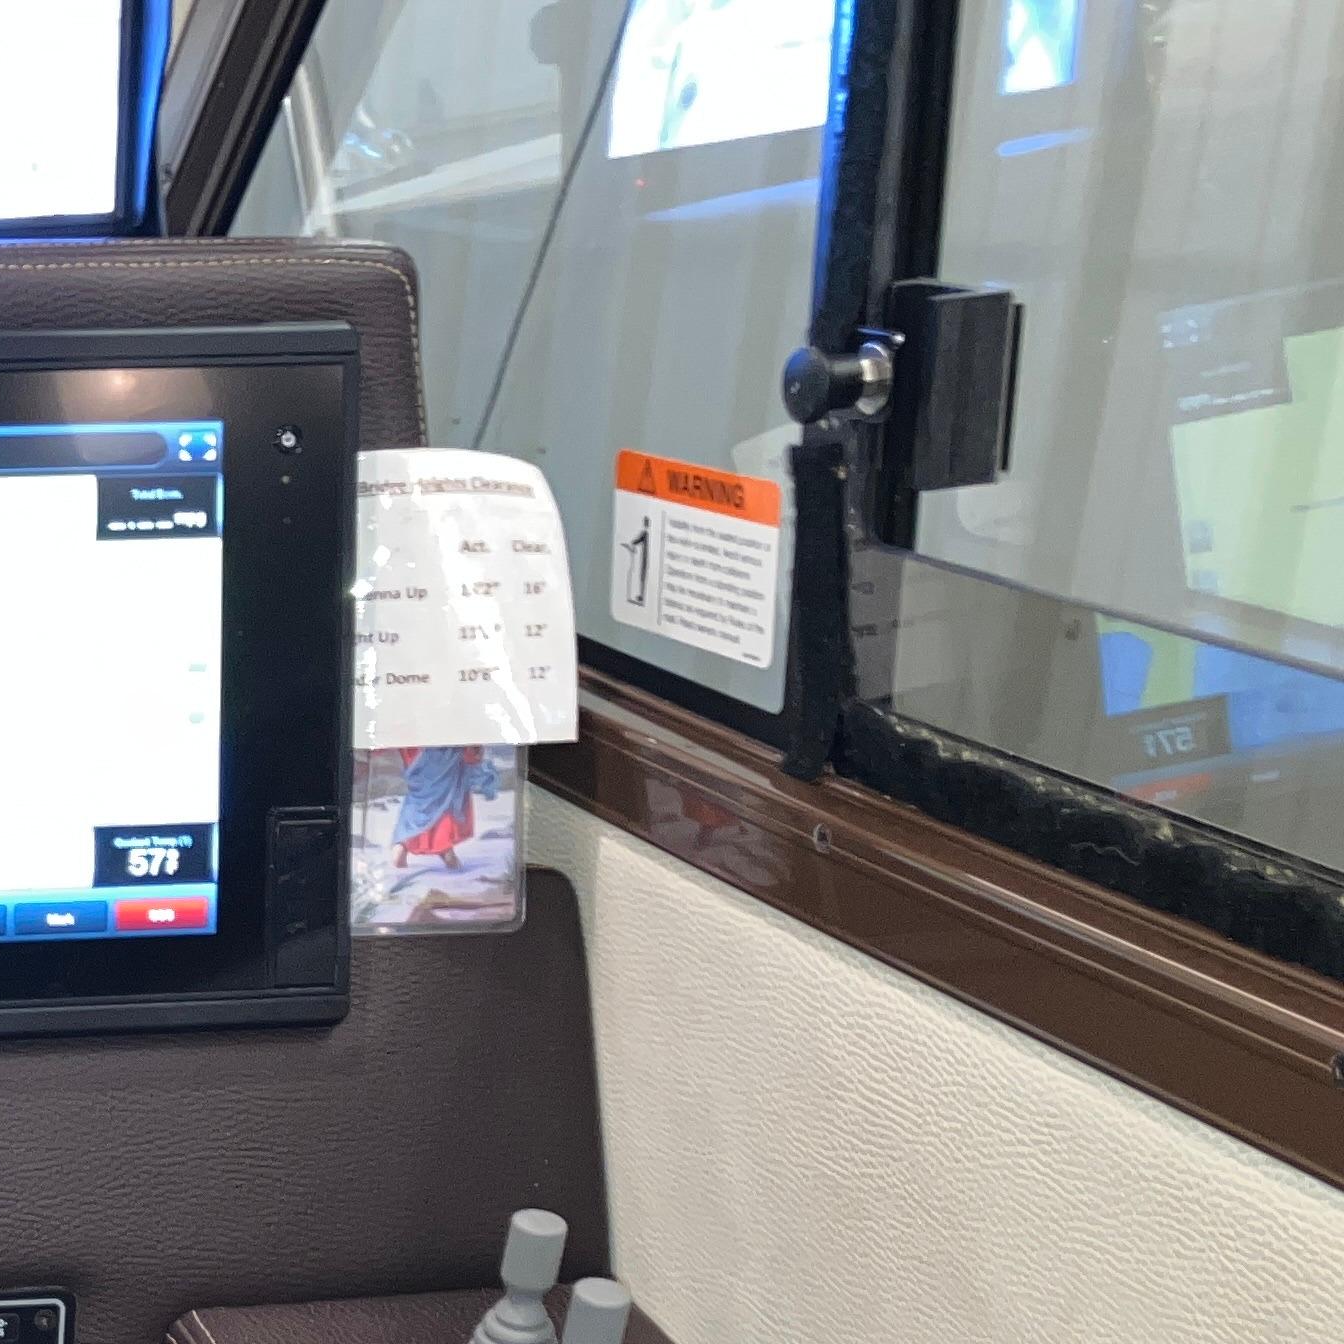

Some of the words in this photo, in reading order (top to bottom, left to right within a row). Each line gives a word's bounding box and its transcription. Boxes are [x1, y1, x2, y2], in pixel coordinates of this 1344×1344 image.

[667, 470, 746, 508] WARNING
[406, 587, 427, 599] Up
[378, 632, 399, 644] Up
[386, 672, 430, 685] Dome
